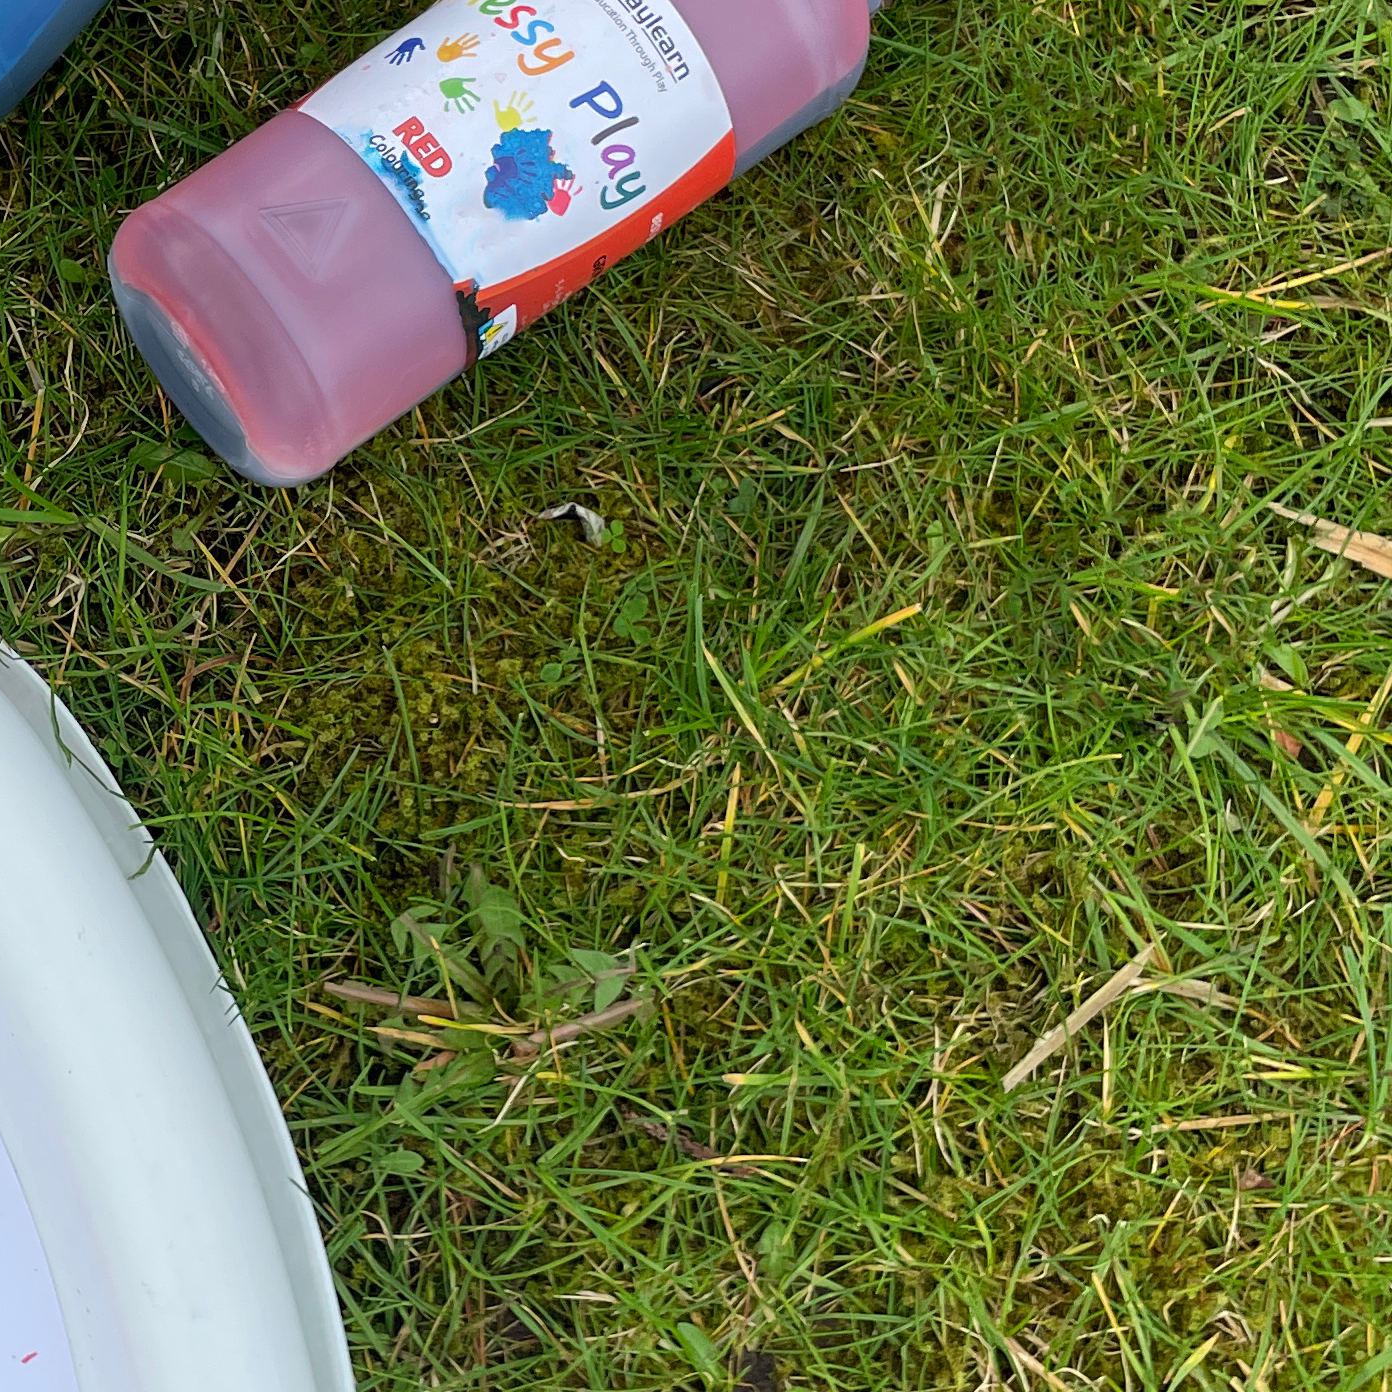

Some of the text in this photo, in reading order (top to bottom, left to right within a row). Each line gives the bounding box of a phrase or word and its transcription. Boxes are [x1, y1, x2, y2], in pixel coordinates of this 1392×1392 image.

[625, 28, 657, 73] Through
[651, 70, 668, 94] Play
[391, 115, 453, 179] RED
[568, 80, 647, 211] Play
